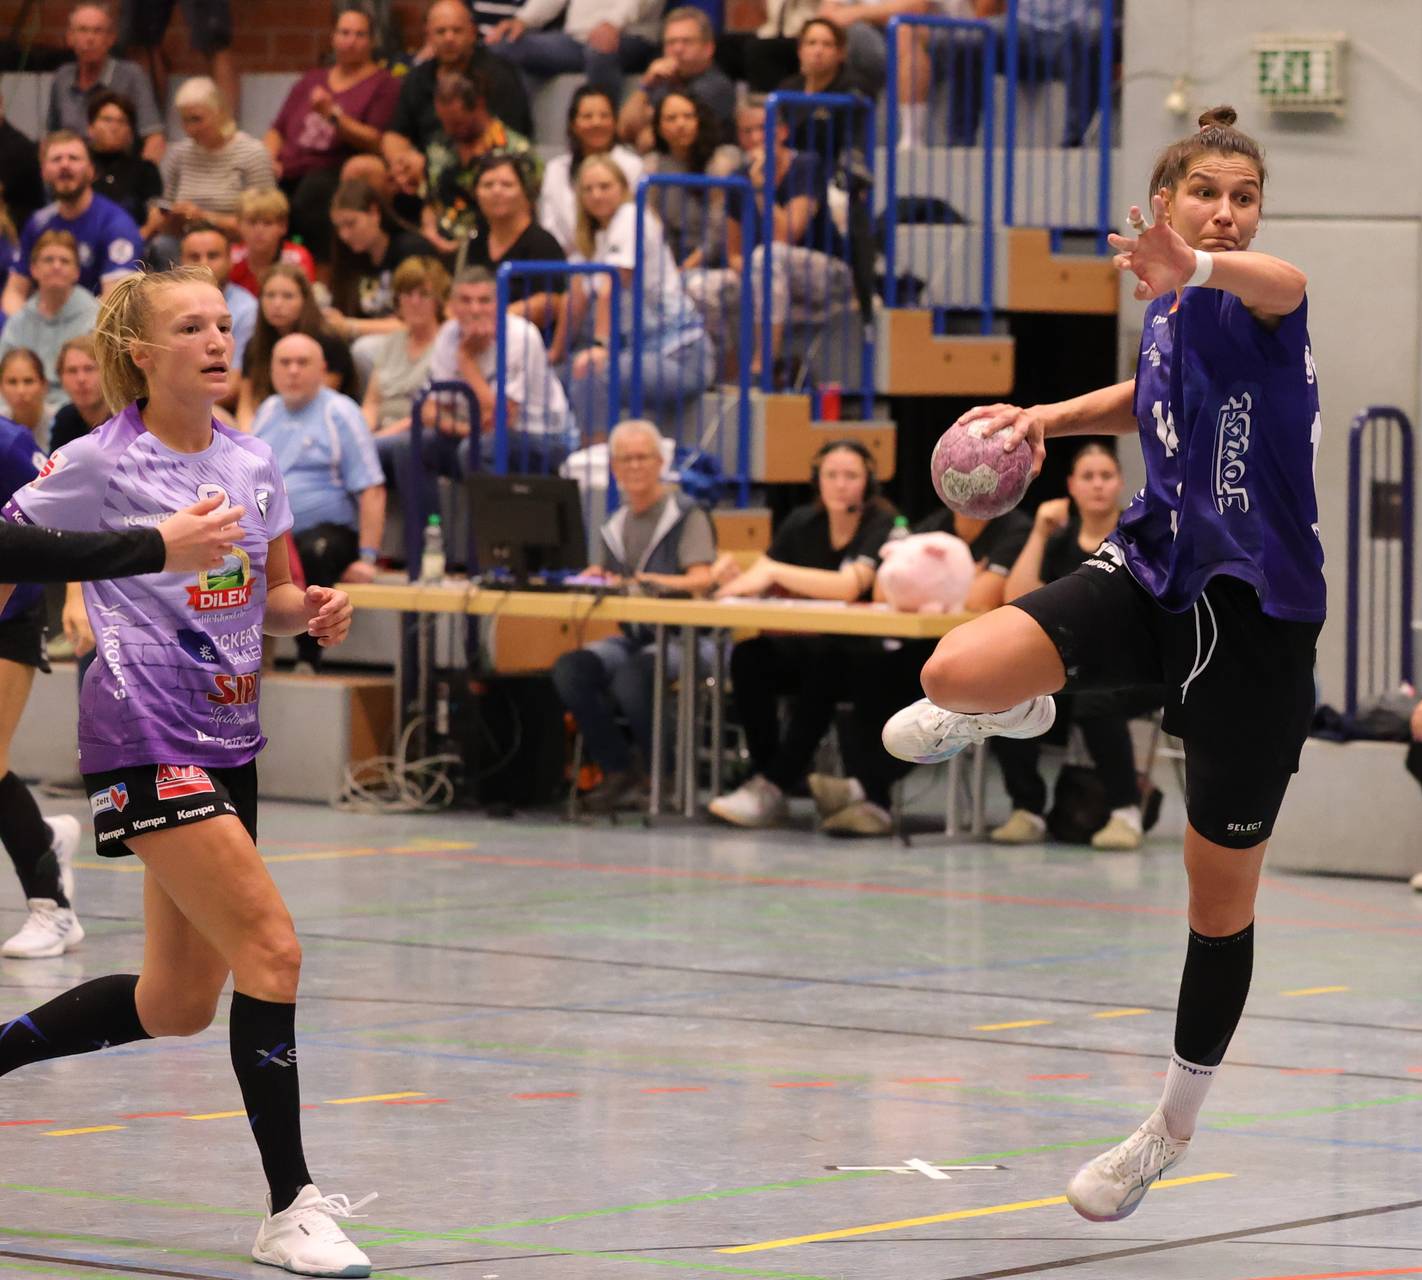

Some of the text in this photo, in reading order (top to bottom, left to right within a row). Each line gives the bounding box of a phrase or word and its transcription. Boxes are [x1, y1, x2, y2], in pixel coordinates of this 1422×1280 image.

[98, 827, 126, 843] Kempa
[132, 815, 167, 831] Kempa
[177, 804, 215, 820] Kempa
[1226, 820, 1263, 832] SELECT
